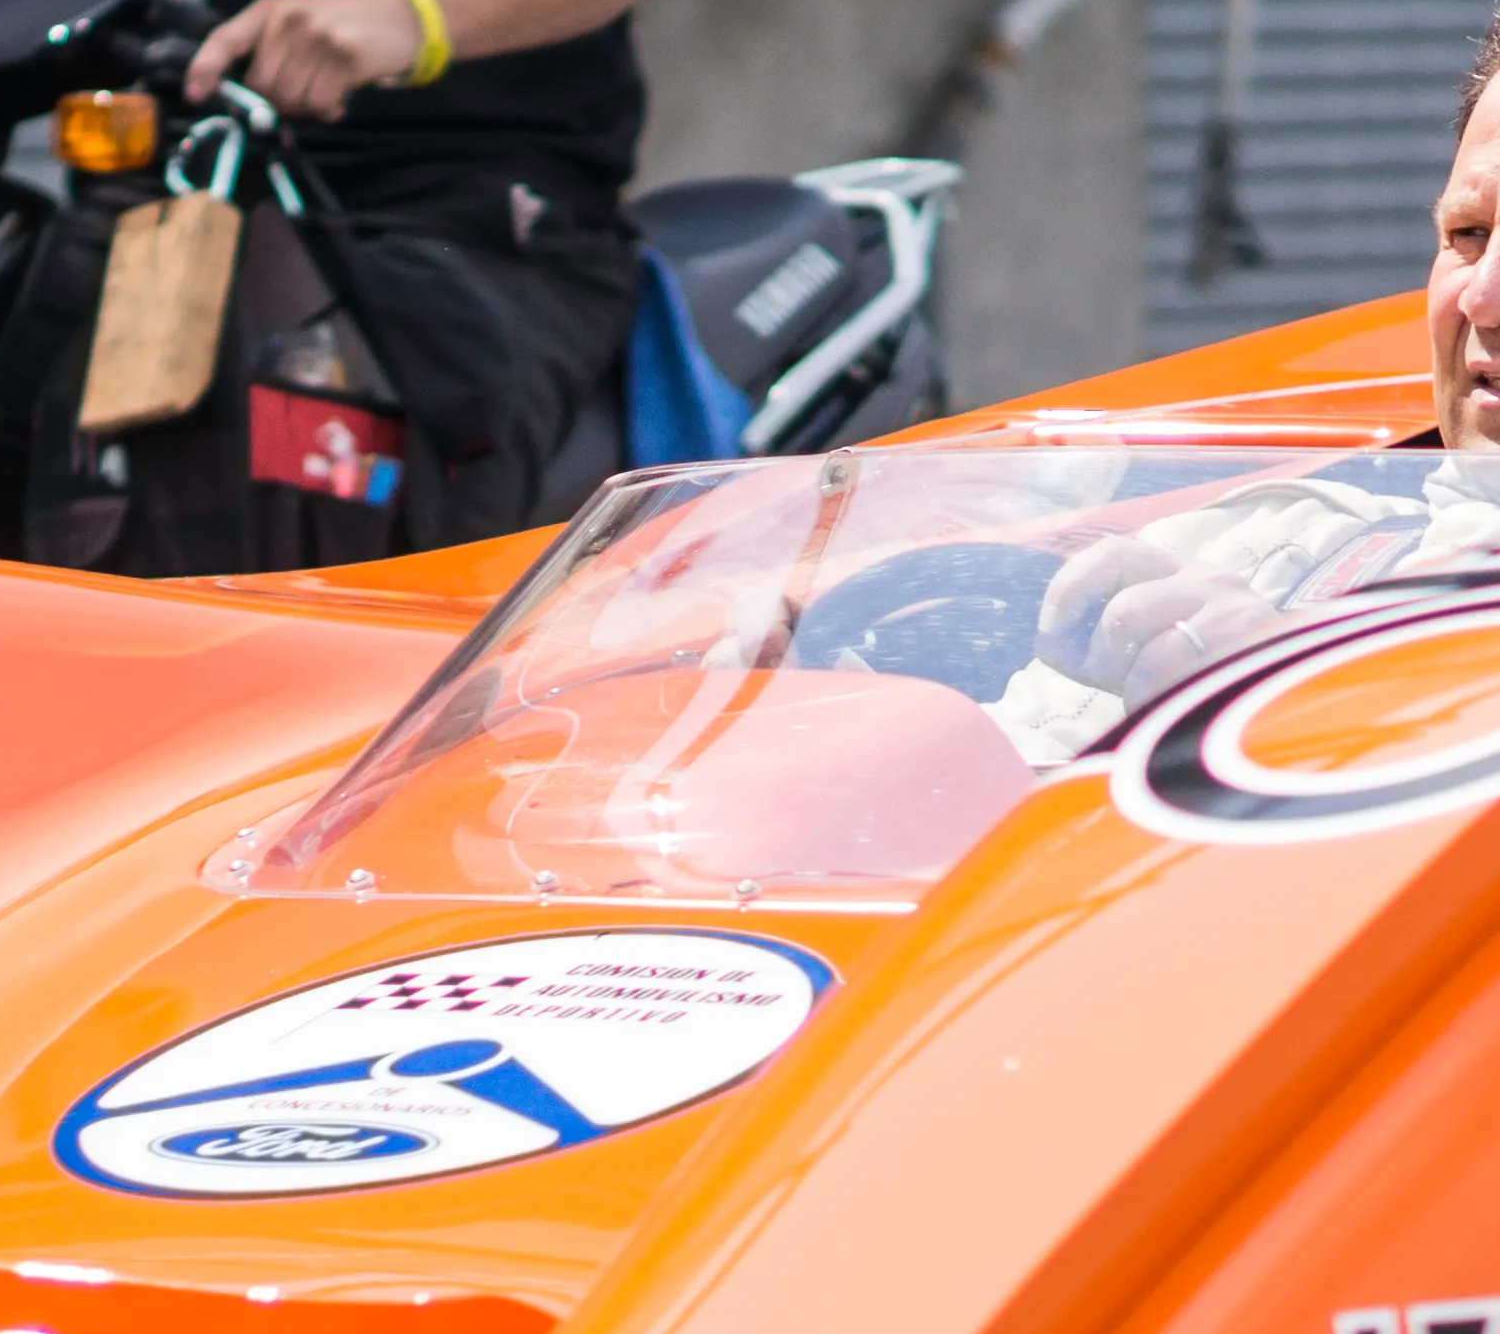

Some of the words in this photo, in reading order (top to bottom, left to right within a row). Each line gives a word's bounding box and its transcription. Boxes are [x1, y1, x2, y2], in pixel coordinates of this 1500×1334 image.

[564, 962, 717, 983] COMISION
[716, 968, 759, 984] DE
[529, 983, 785, 1008] AUTOMOVILISMO
[492, 1002, 689, 1025] DEPORTIVO
[246, 1098, 476, 1117] CONCESIONARIOS
[195, 1124, 389, 1160] Ford
